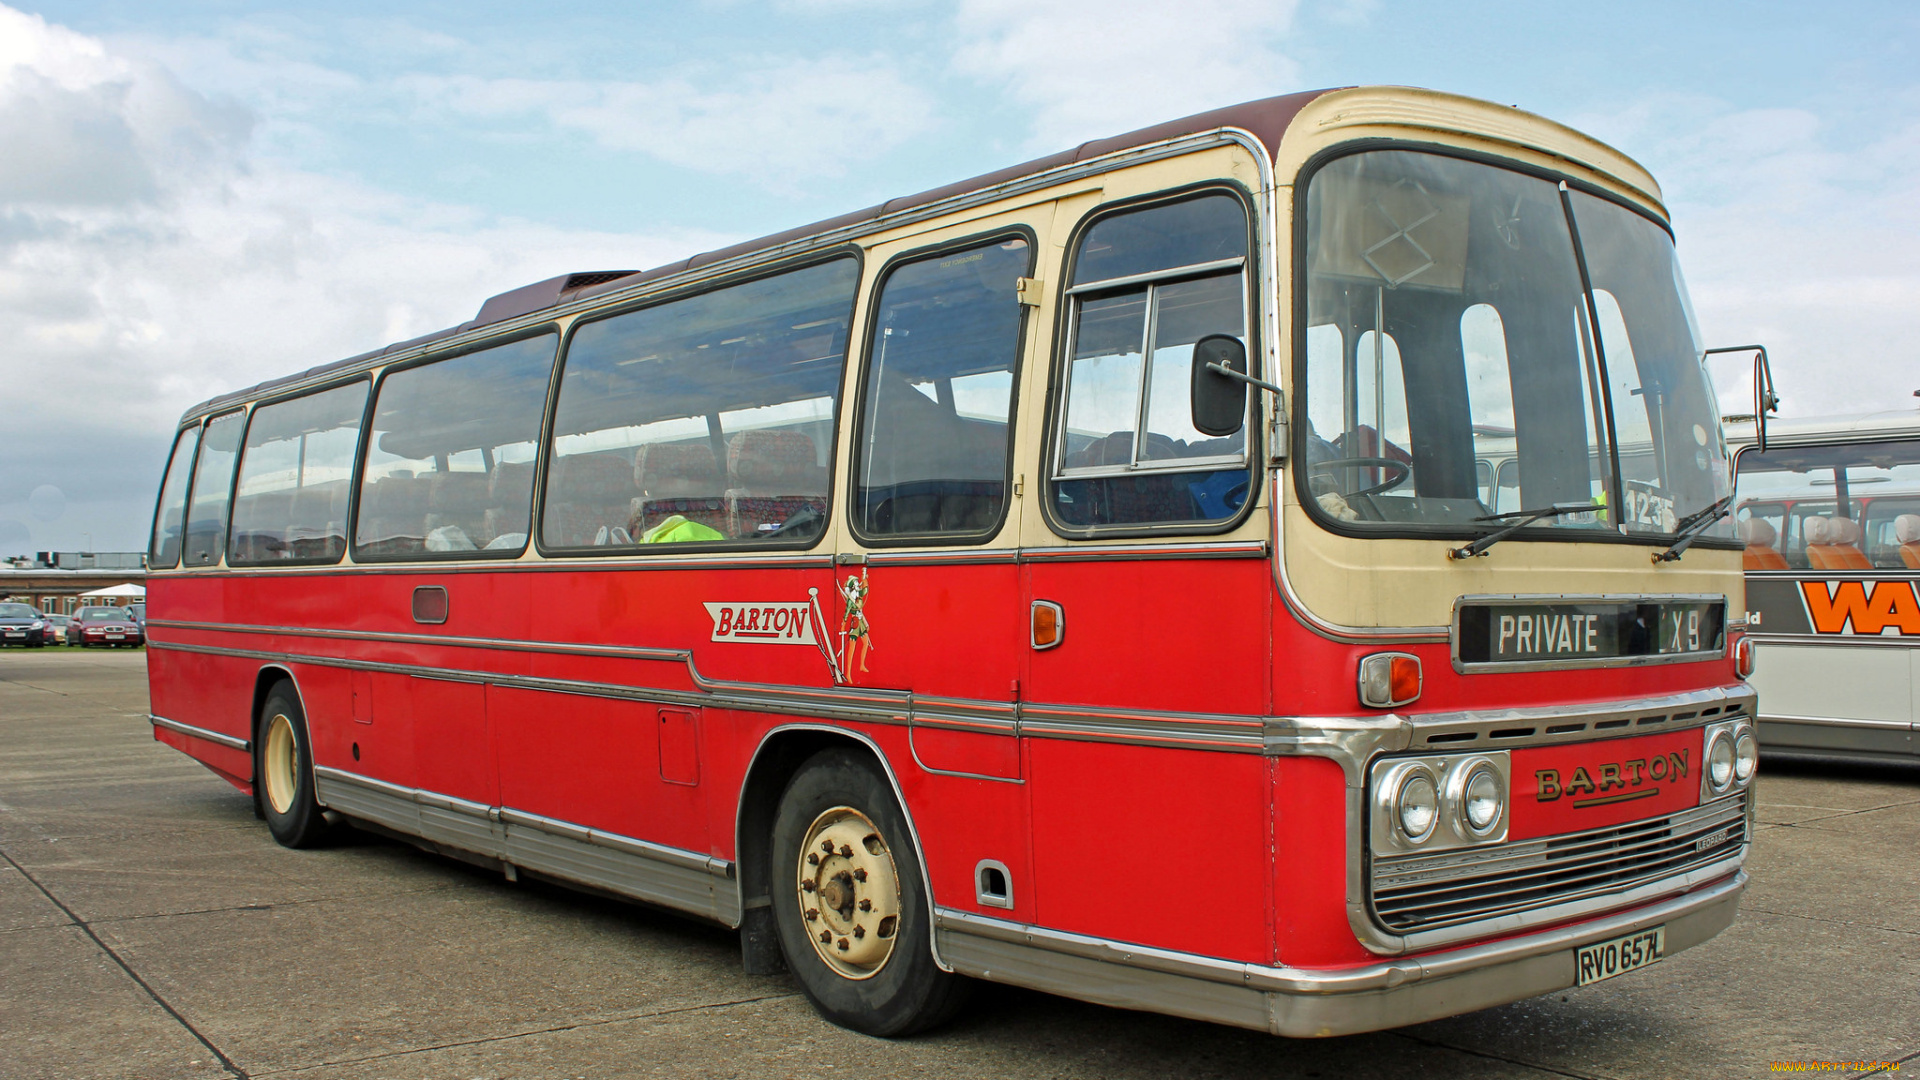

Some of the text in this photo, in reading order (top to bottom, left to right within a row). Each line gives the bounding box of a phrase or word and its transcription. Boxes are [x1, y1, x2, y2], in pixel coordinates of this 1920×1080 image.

[716, 607, 808, 638] BARTON
[1499, 614, 1598, 654] PRIVATE
[1535, 748, 1689, 802] BARTON
[1580, 931, 1663, 983] RVO 657L
